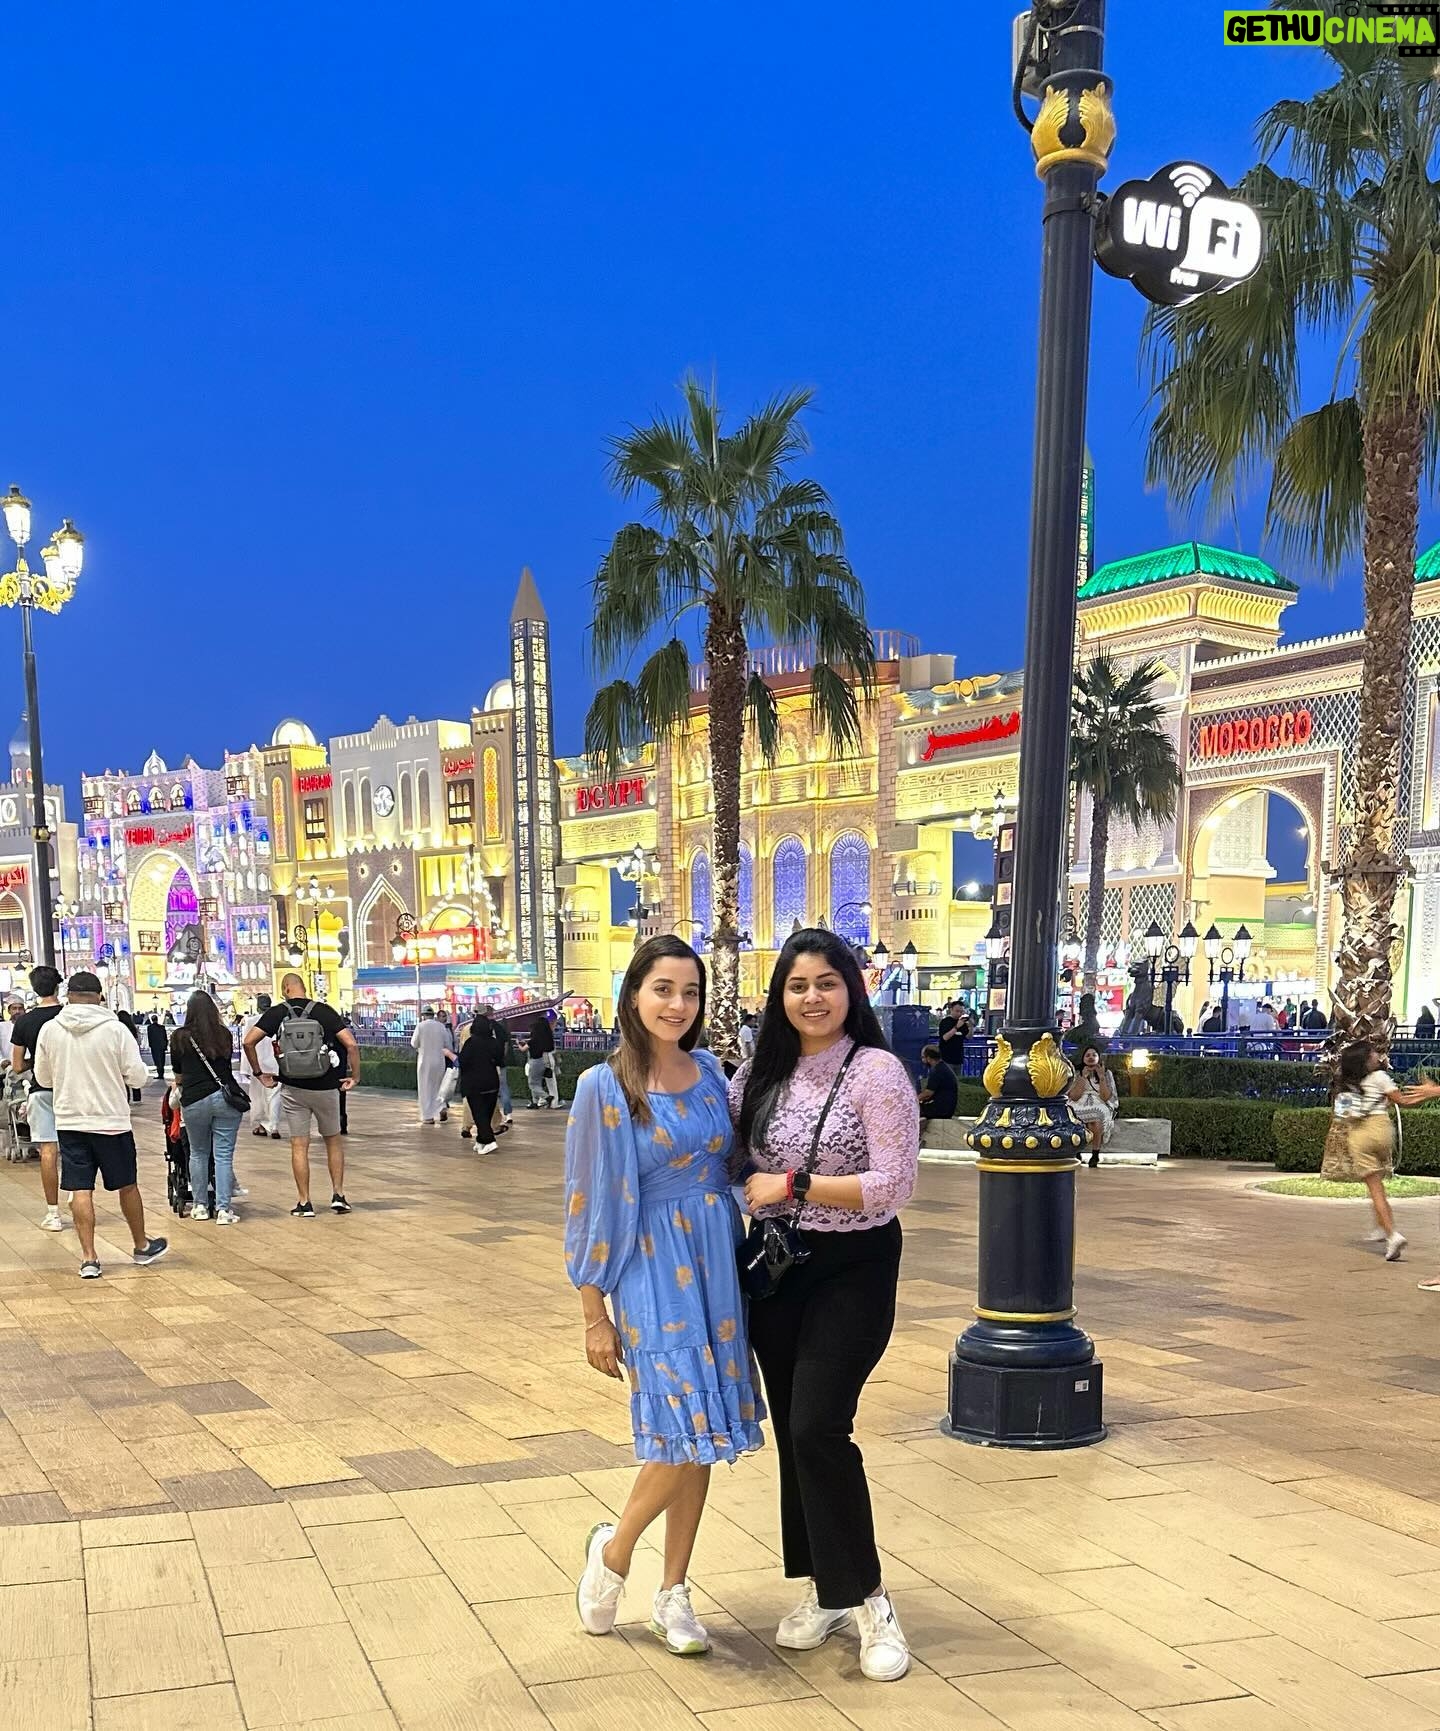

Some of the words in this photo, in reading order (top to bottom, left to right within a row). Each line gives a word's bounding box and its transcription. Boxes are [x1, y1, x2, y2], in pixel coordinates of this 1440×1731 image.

[1123, 197, 1182, 251] Wi
[1207, 217, 1242, 260] Fi
[1199, 708, 1312, 760] MOROCCO
[576, 777, 647, 813] EGYPT
[122, 825, 156, 848] YEMEN
[157, 821, 194, 849] اليمن
